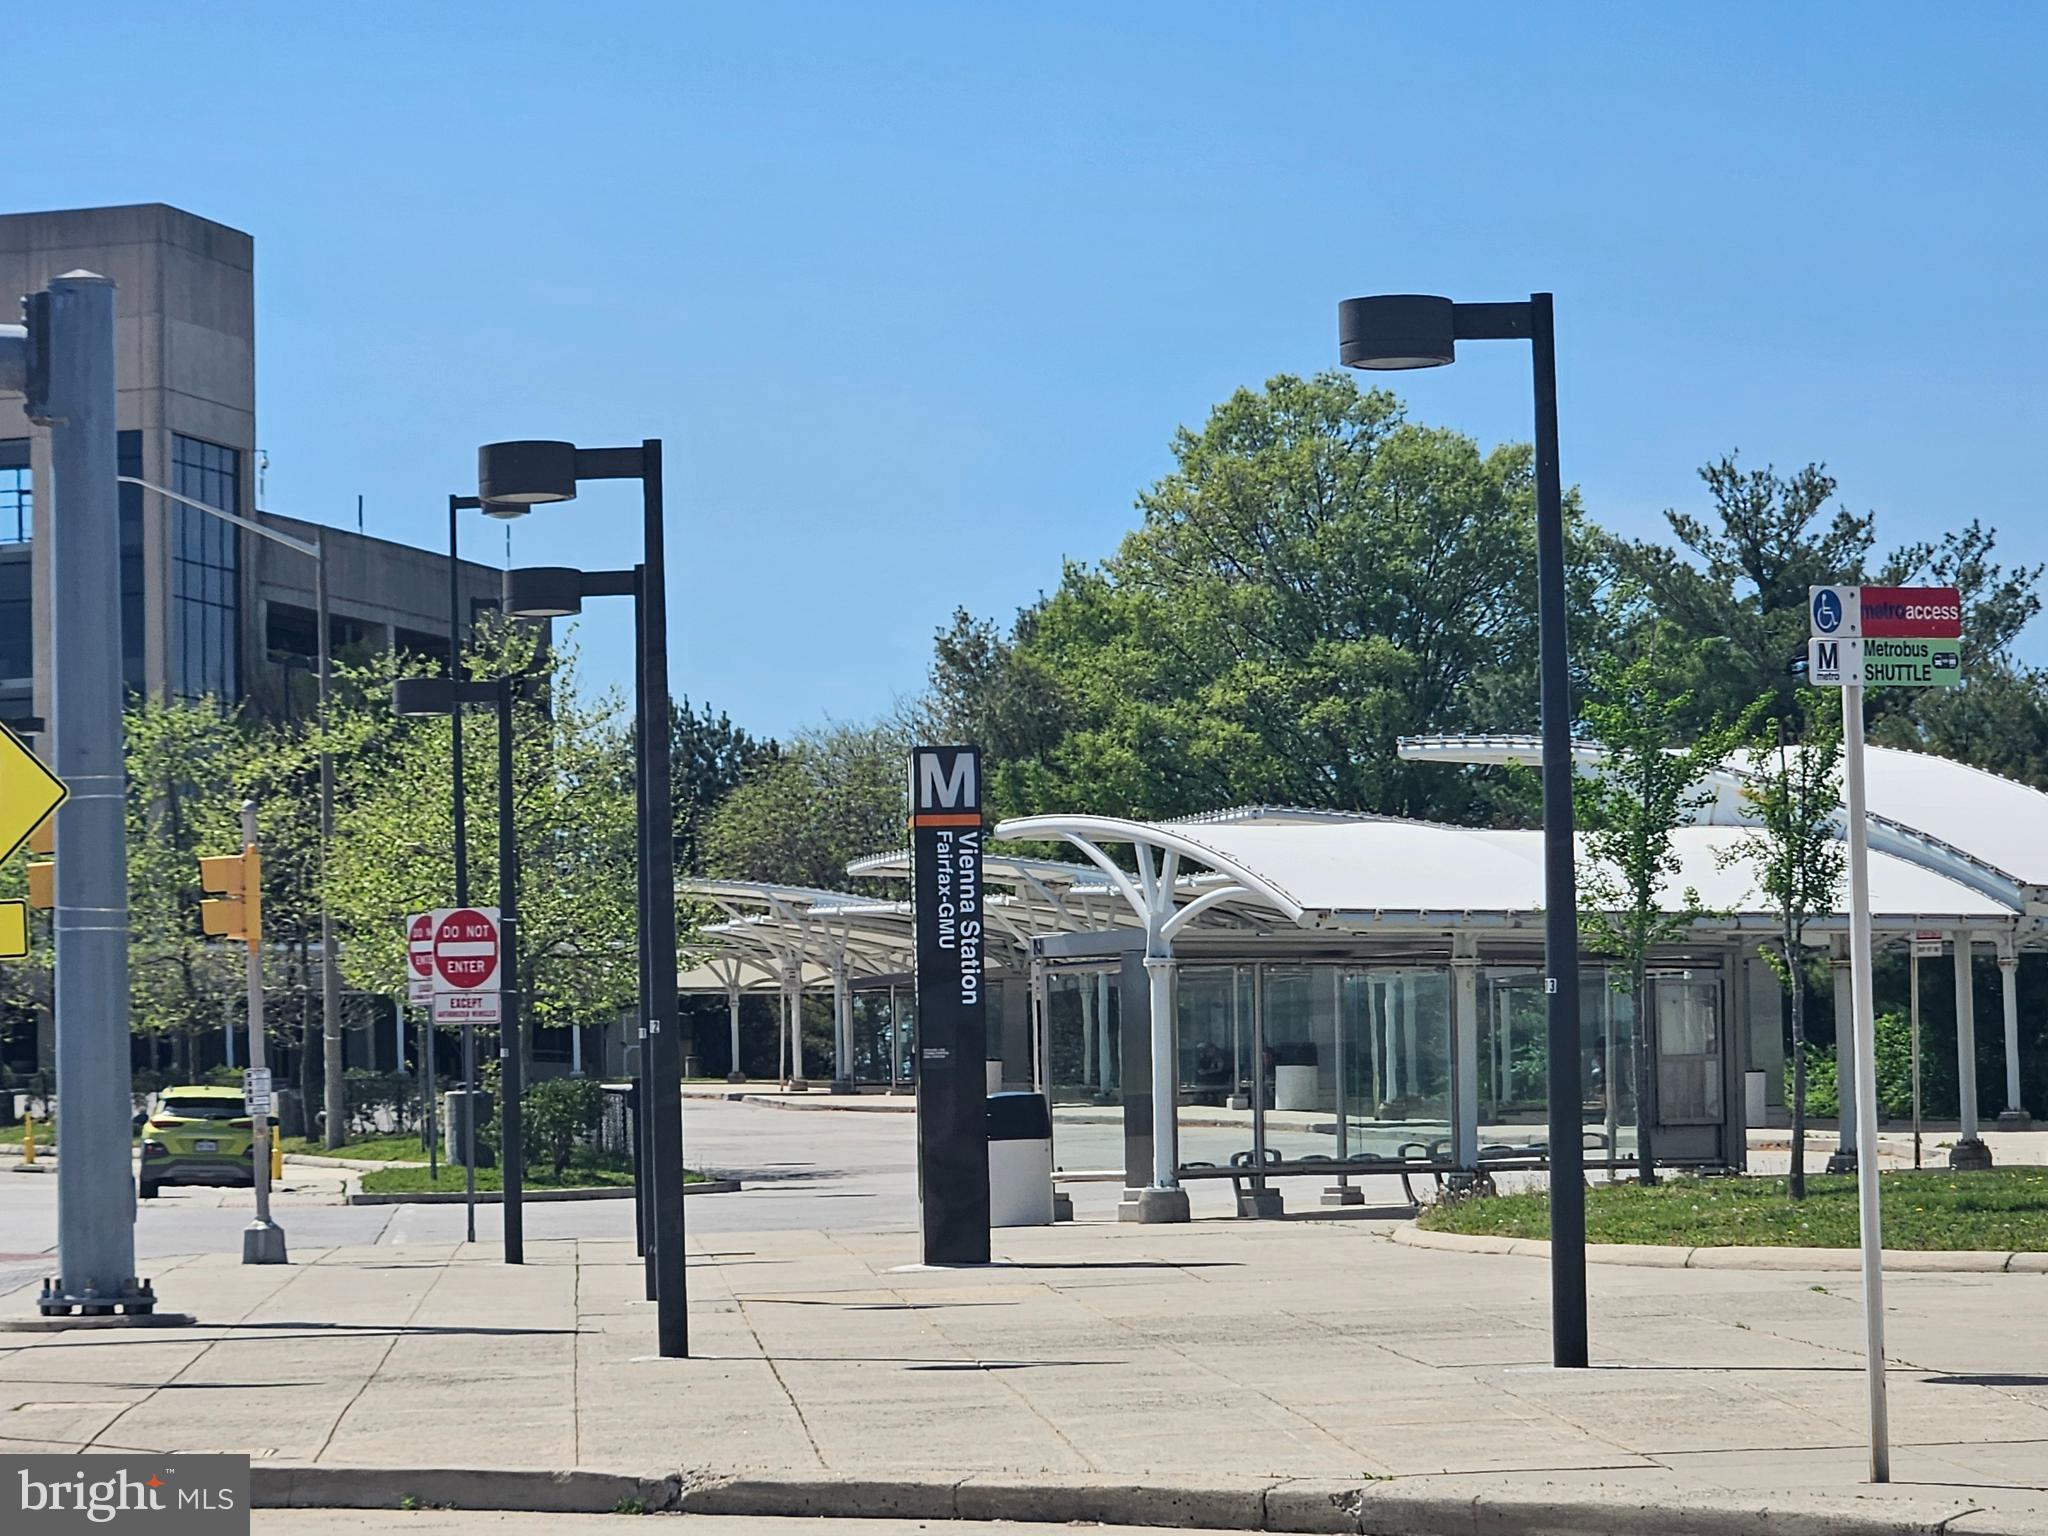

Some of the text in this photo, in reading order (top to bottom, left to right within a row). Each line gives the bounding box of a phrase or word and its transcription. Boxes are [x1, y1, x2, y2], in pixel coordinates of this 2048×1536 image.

[1861, 603, 1959, 621] metroaccess
[1818, 643, 1838, 669] M
[1864, 640, 1929, 658] Metrobus
[1817, 673, 1840, 681] metro
[1864, 664, 1932, 681] SHUTTLE
[919, 752, 976, 808] M
[936, 831, 956, 949] Fairfax-GMU
[958, 831, 981, 1005] Vienna Station
[443, 926, 459, 938] DO
[466, 925, 490, 938] NOT
[448, 960, 485, 973] ENTER
[450, 998, 482, 1008] EXCEPT
